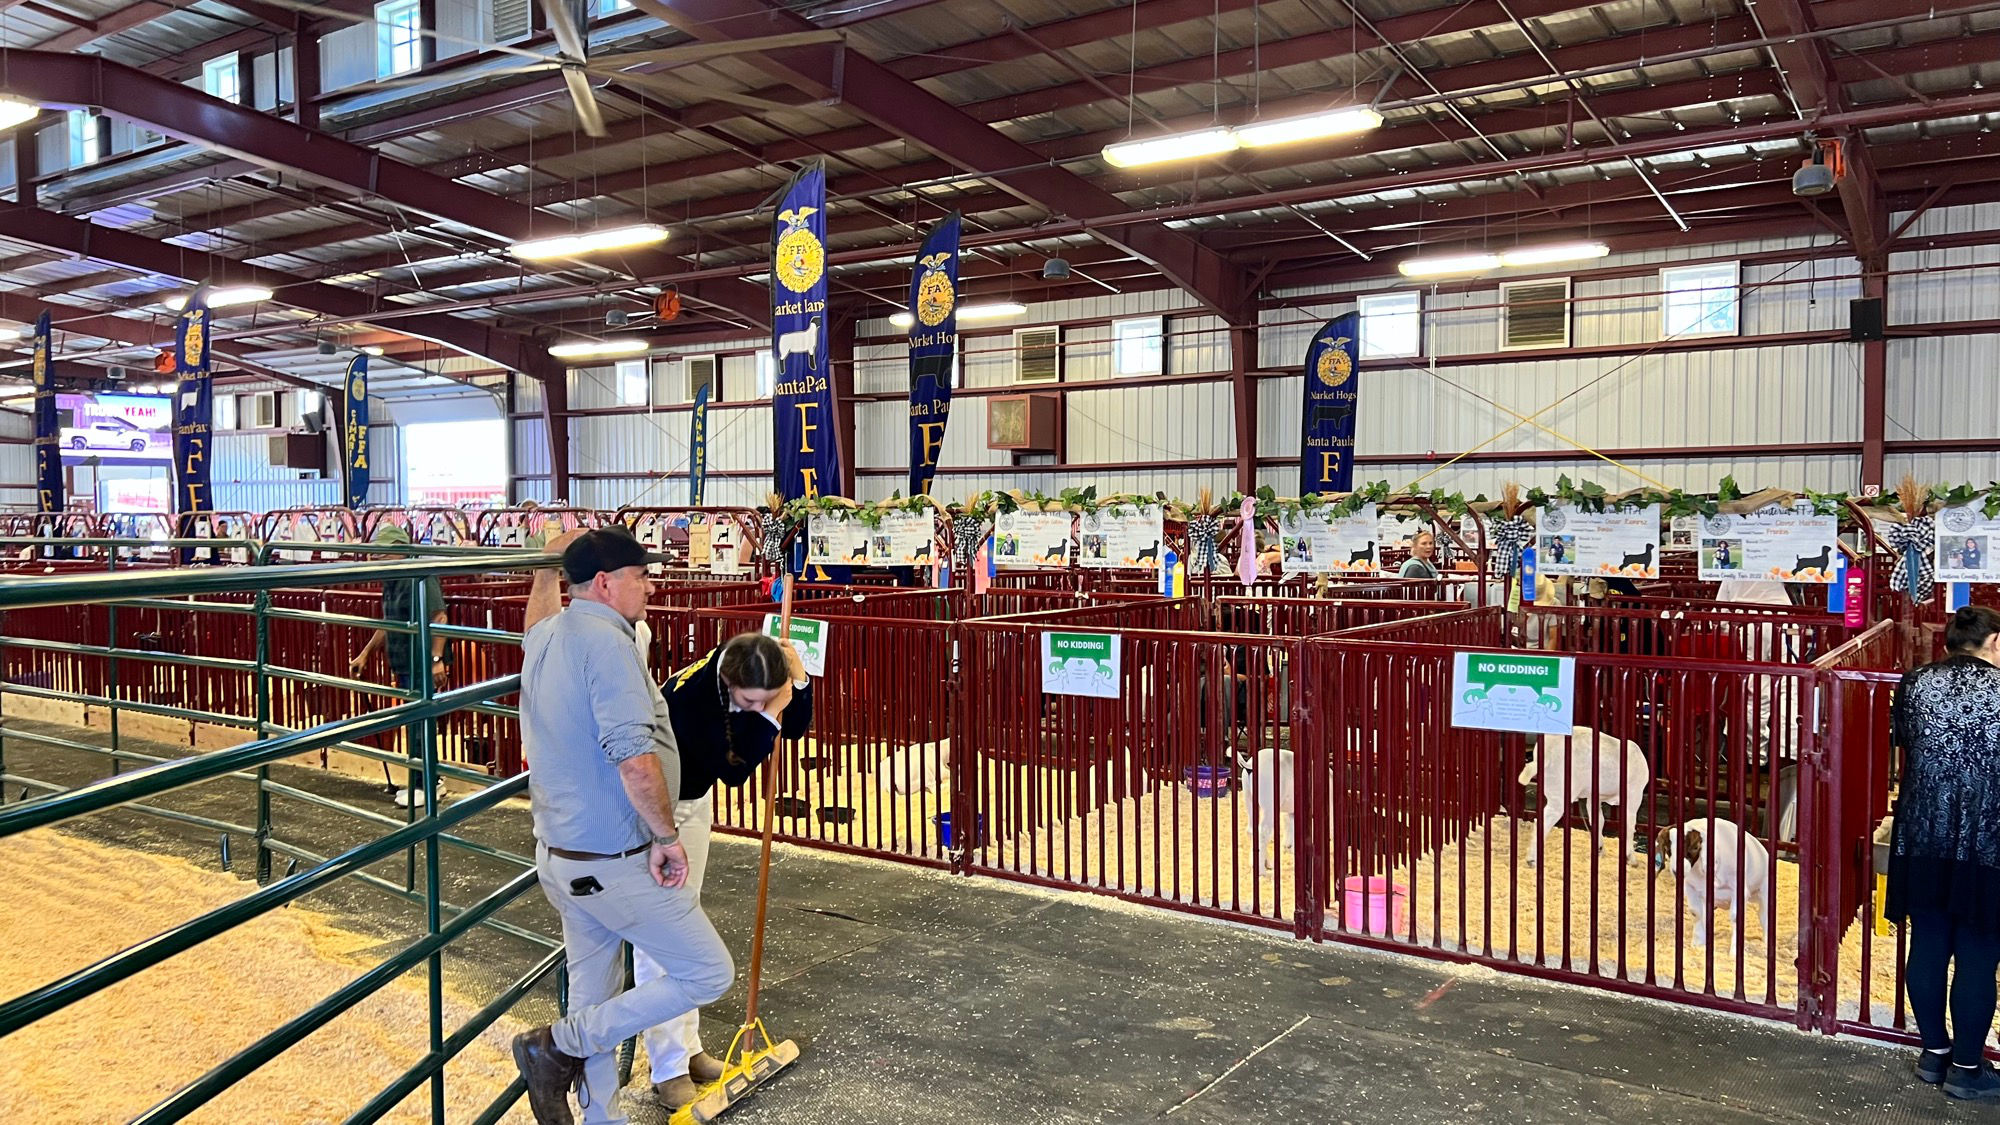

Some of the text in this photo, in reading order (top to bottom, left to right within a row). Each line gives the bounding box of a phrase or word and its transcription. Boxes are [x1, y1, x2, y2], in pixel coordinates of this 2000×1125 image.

[124, 406, 156, 416] YEAH!
[1307, 435, 1329, 447] Santa
[1057, 640, 1104, 650] NO KIDDING!
[1478, 663, 1549, 675] NO KIDDING!
